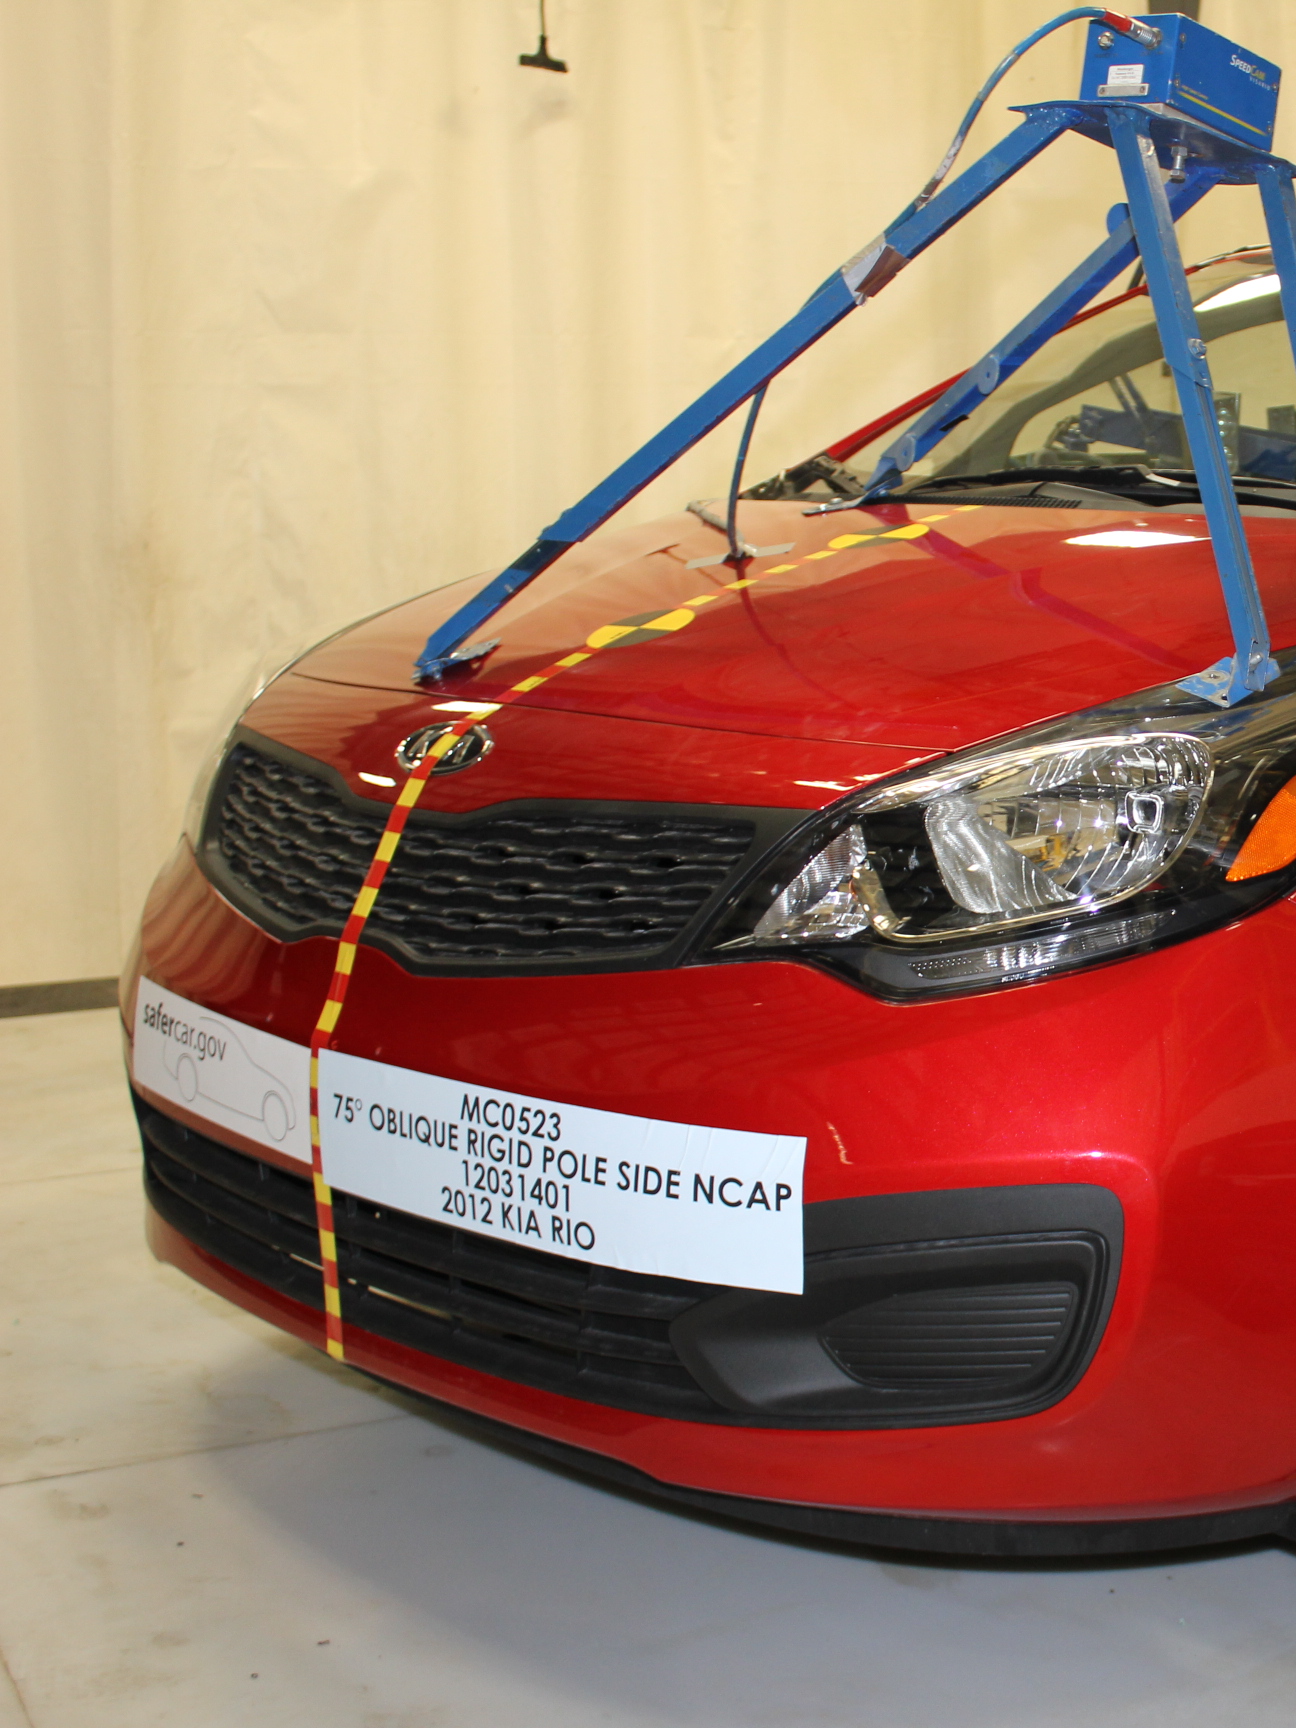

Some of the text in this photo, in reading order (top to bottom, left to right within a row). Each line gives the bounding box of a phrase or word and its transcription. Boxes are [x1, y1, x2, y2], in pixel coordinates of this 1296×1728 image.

[143, 1002, 227, 1061] safercar.gov
[460, 1094, 561, 1142] MC0523
[369, 1104, 458, 1151] OBLIQUE
[467, 1128, 533, 1168] RIGID
[543, 1147, 606, 1186] POLE
[617, 1161, 680, 1199] SIDE
[693, 1175, 792, 1212] NCAP
[461, 1160, 570, 1212] 12031401
[441, 1187, 596, 1251] 2012 KIA RIO
